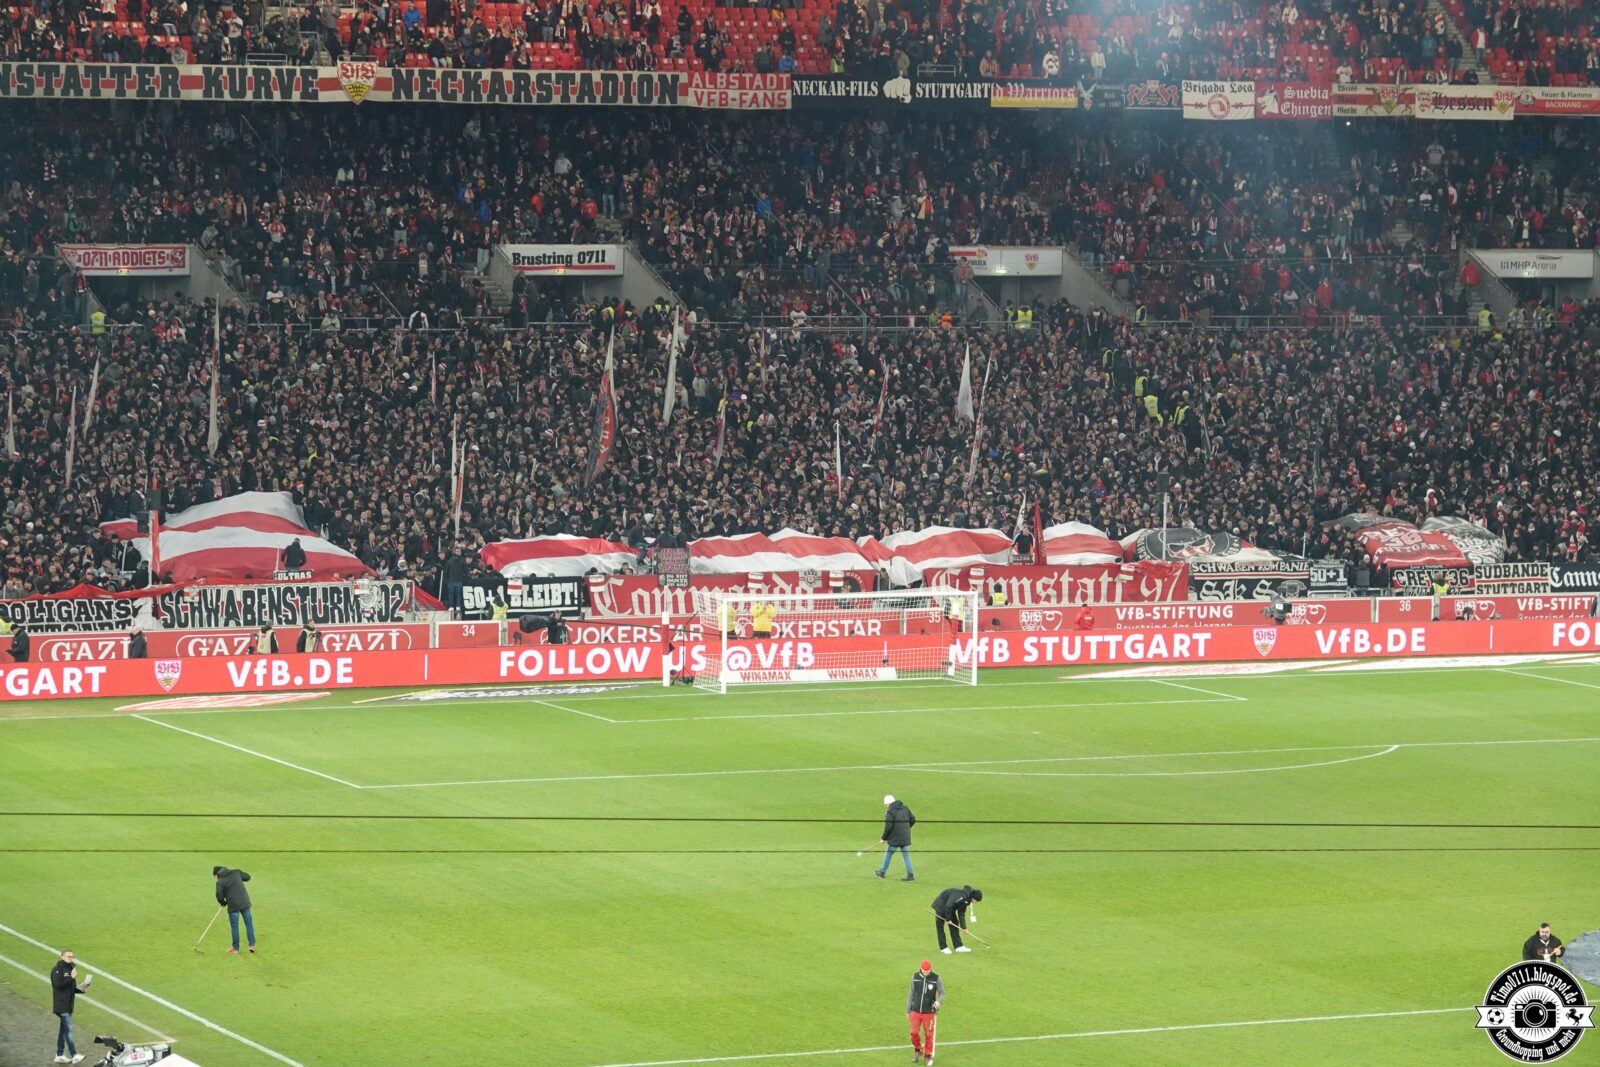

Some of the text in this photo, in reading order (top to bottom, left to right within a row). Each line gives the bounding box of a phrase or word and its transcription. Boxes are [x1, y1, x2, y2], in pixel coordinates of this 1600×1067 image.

[202, 66, 319, 101] KURVE
[391, 69, 679, 104] NECKARSTADION
[692, 72, 791, 89] ALBSTADT
[792, 80, 991, 98] NECKAR-FILS STUTTGART
[1183, 81, 1254, 95] Brigada Loca
[693, 90, 788, 108] VFB-FANS
[1007, 81, 1076, 102] Warriors
[112, 250, 167, 266] ADDICTS
[511, 250, 606, 267] Brustring 0711
[1510, 260, 1557, 270] MHP Arena
[277, 571, 312, 581] ULTRAS
[1310, 567, 1348, 582] 50+1
[1474, 563, 1549, 580] SÜDBANDE
[1476, 580, 1549, 595] STUTTGART
[1115, 605, 1234, 621] VfB-STIFTUNG
[1399, 600, 1411, 612] 36
[928, 611, 942, 623] 35
[462, 624, 476, 637] 34
[1023, 632, 1212, 664] STUTTGART
[1314, 626, 1426, 655] VfB.DE
[500, 645, 651, 677] FOLLOW
[726, 640, 816, 671] @VfB
[227, 657, 354, 688] VfB.DE
[740, 668, 878, 682] WINAMAX WINAMAX
[0, 666, 107, 698] GART
